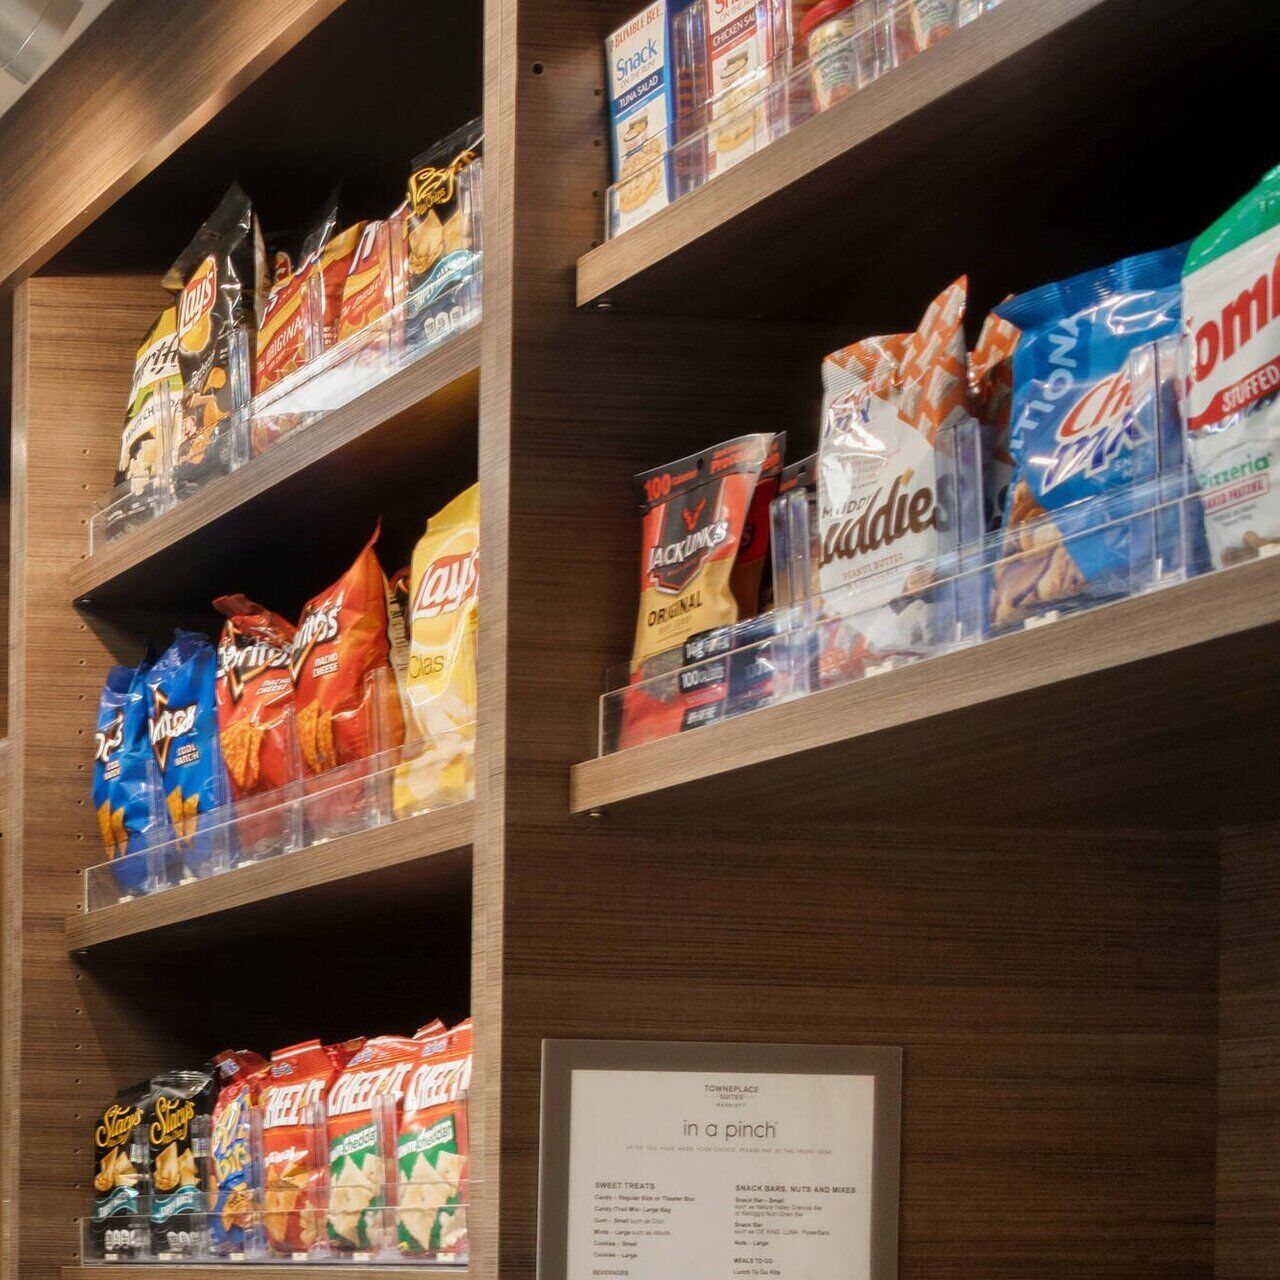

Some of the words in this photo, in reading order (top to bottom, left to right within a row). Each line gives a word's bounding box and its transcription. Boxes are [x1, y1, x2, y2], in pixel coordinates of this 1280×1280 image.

[713, 22, 739, 46] CHICKEN
[739, 11, 756, 30] SAL
[616, 38, 658, 82] Snack
[619, 88, 637, 108] TUNA
[638, 75, 658, 97] SALAD
[265, 317, 304, 365] ORIGINA
[1222, 365, 1280, 413] STUFFED
[644, 473, 673, 502] 100
[819, 474, 958, 569] uddies
[647, 540, 683, 574] JACK
[647, 590, 704, 628] ORIGINAL
[313, 663, 338, 678] CHEESE
[409, 654, 445, 679] Clas
[704, 1085, 759, 1093] TOWNEPLACE
[95, 1104, 144, 1148] Stacy's
[149, 1096, 195, 1145] Stacy's
[683, 1120, 698, 1136] in
[705, 1123, 718, 1137] a
[725, 1121, 775, 1141] pinch
[595, 1182, 621, 1190] SWEET
[624, 1182, 656, 1190] TREATS
[832, 1186, 856, 1194] MIXES
